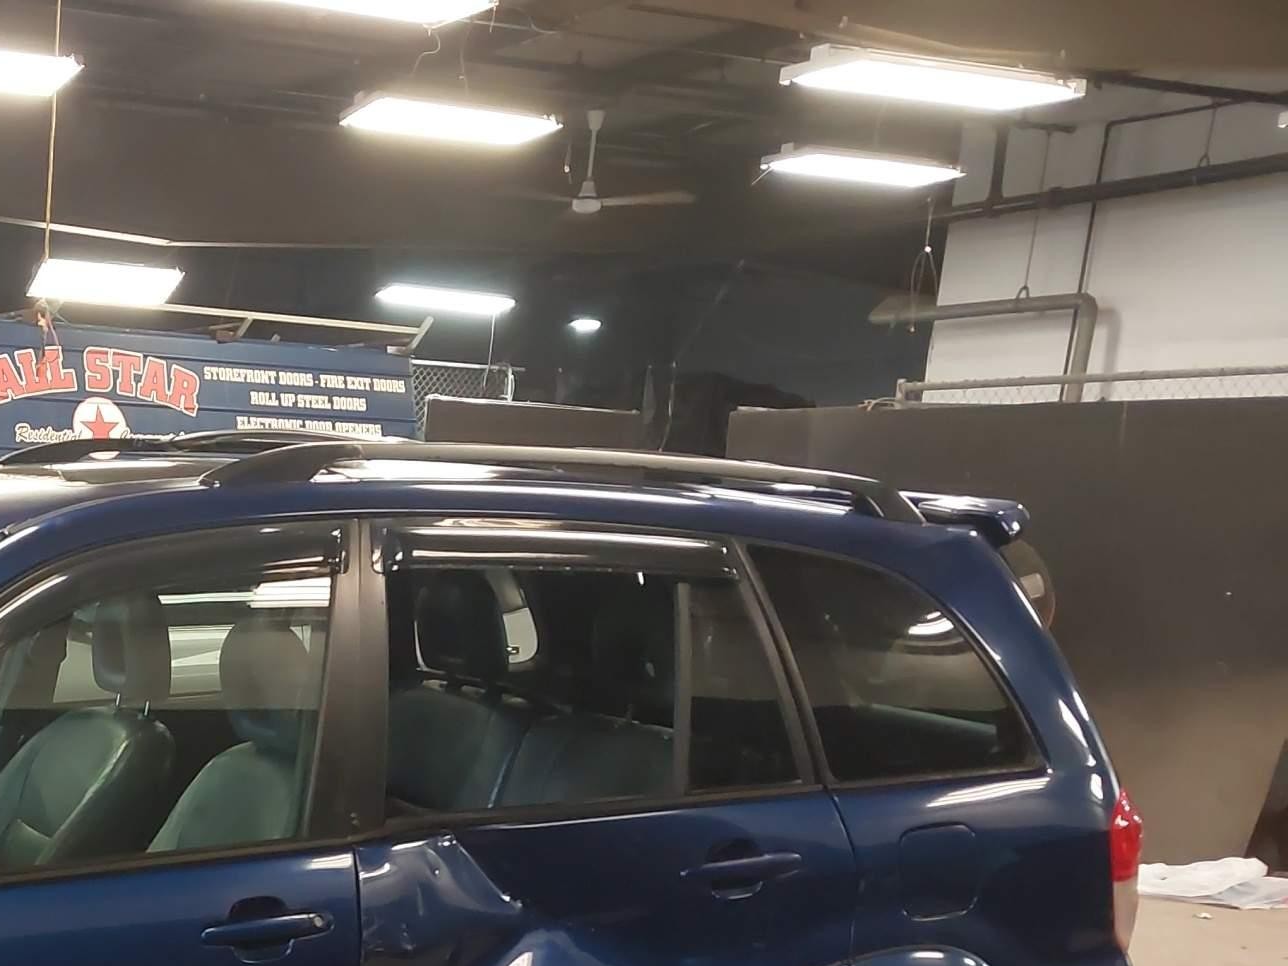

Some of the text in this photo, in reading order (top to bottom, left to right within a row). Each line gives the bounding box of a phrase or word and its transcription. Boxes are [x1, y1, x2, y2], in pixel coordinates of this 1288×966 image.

[84, 346, 200, 417] STAR
[203, 366, 277, 385] STOREFRONT
[278, 371, 314, 387] DOORS
[319, 374, 345, 389] FIRE
[346, 376, 371, 391] EXIT
[373, 378, 406, 393] DOORS
[250, 391, 367, 412] ROLL UP STEEL DOORS
[236, 416, 382, 436] ELECTRONIC DOOR OPENERS
